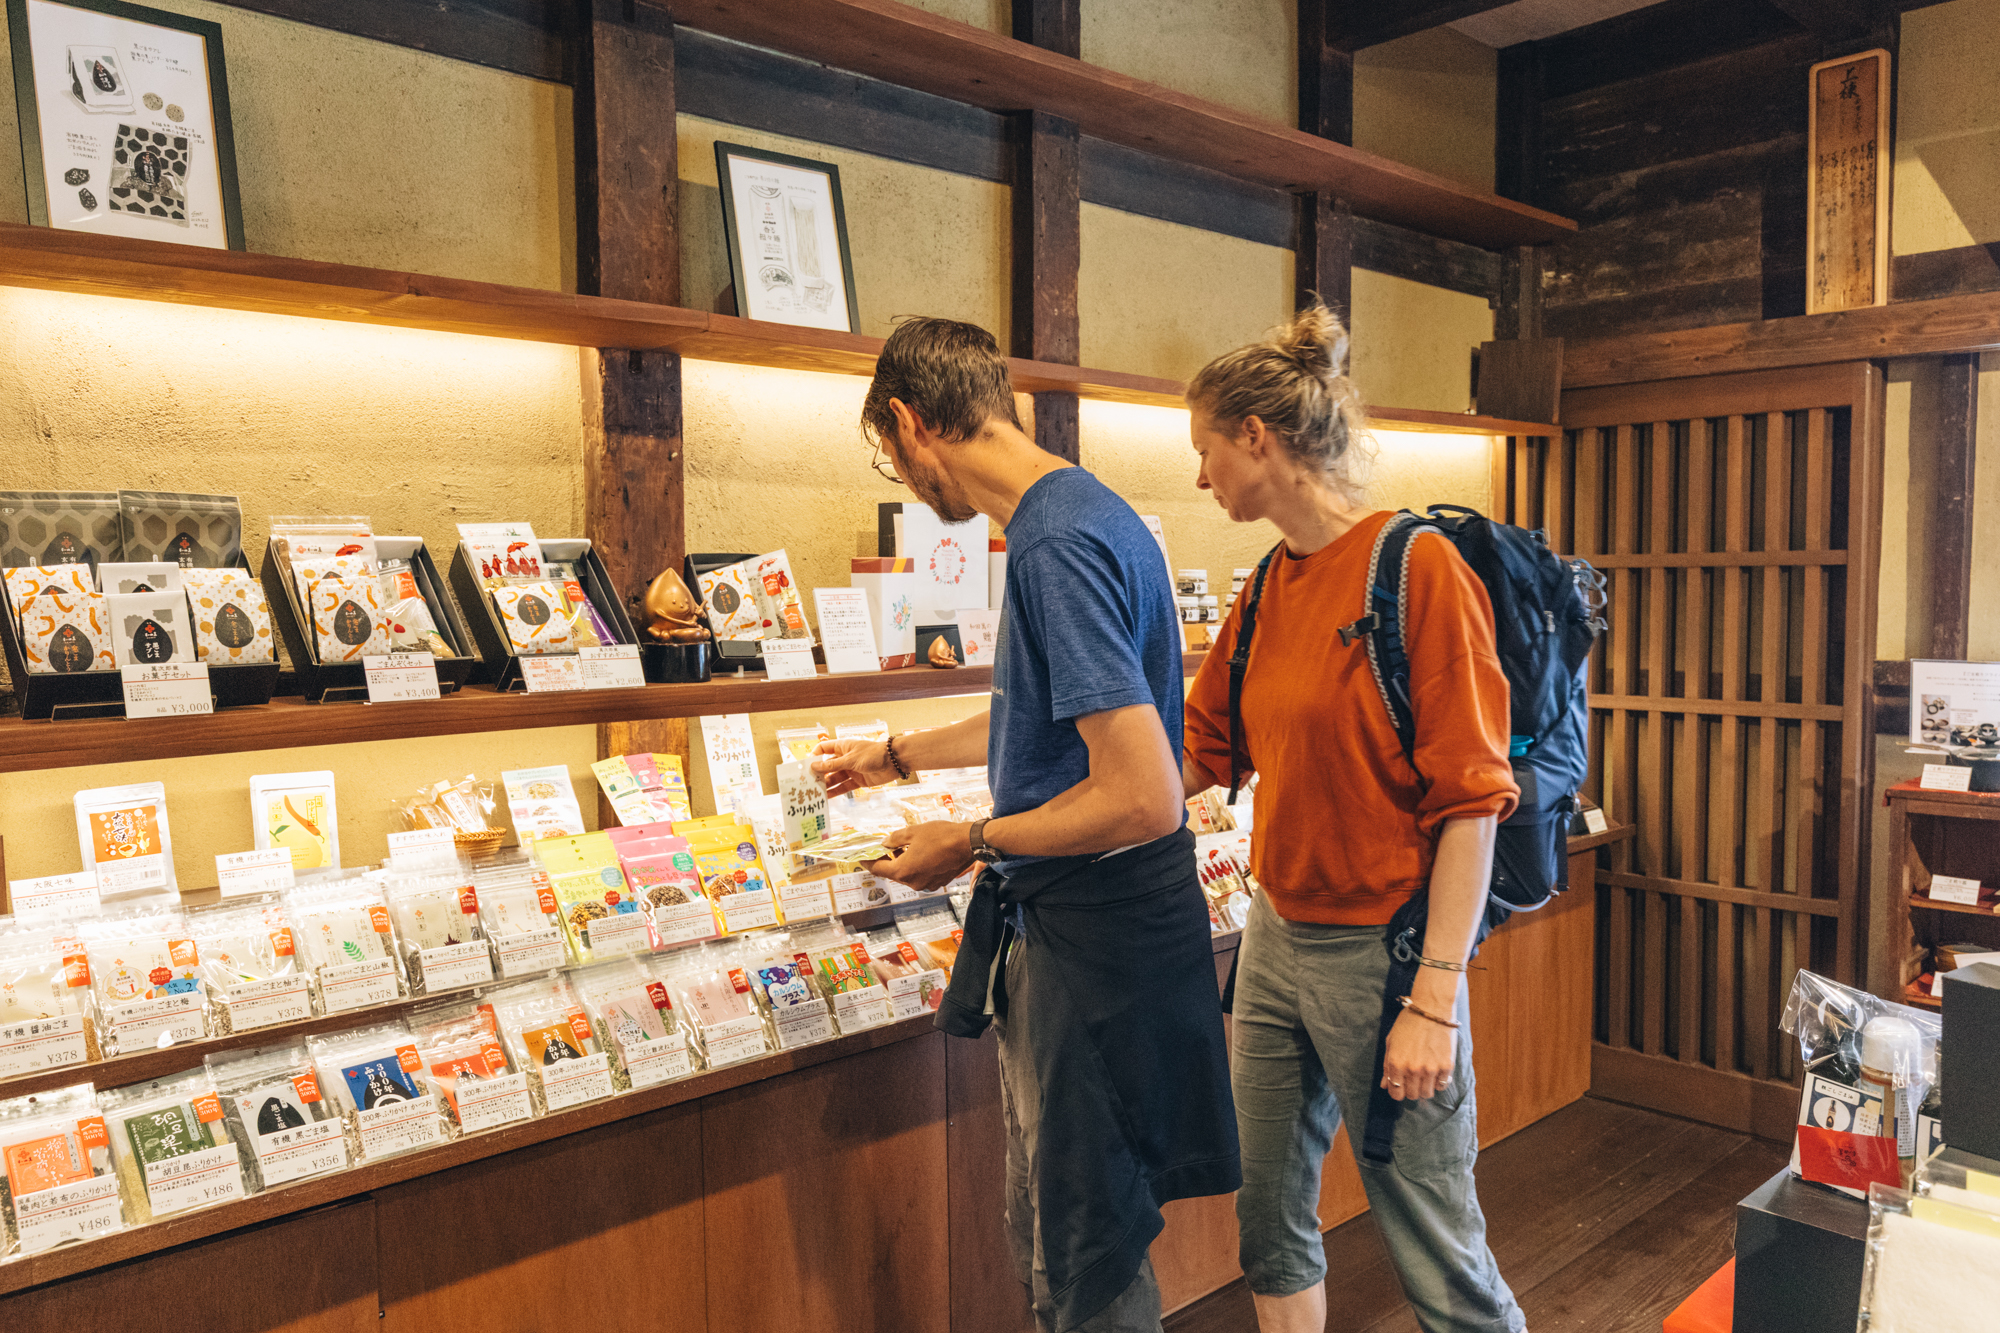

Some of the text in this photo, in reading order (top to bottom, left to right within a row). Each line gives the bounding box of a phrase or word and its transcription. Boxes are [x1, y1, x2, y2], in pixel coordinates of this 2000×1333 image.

[144, 642, 153, 659] サブレ
[377, 660, 423, 668] ごまんぞくセット
[142, 671, 192, 680] お菓子セット
[792, 669, 814, 677] ¥1,350
[615, 677, 642, 685] ¥2,600
[405, 688, 437, 697] ¥3,400
[171, 703, 210, 713] ¥3,000
[712, 750, 750, 762] ふりかけ
[788, 787, 822, 804] ごまやん
[788, 799, 825, 816] ふりかけ
[768, 846, 787, 856] ふり
[227, 851, 281, 864] 有機 ゆず七味
[34, 878, 74, 889] 大阪七味
[786, 883, 823, 896] ごまやんふりかけ
[812, 904, 828, 913] ¥378
[848, 901, 864, 910] ¥378
[756, 915, 772, 924] ¥378
[526, 931, 557, 942] ごまと味噌
[693, 927, 711, 936] ¥378
[450, 944, 486, 954] ごまと赤しそ
[626, 940, 645, 949] ¥378
[353, 961, 390, 974] ごまと山椒
[539, 957, 560, 966] ¥378
[464, 971, 486, 982] ¥378
[174, 983, 193, 994] No.2
[262, 977, 301, 990] ごまと柚子
[368, 989, 392, 1001] ¥378
[773, 983, 802, 997] カルシウム
[781, 991, 800, 1002] プラス
[847, 991, 873, 1002] 大阪セサミ
[121, 997, 189, 1016] 有機ふりかけ ごまと梅
[278, 1006, 303, 1018] ¥378
[780, 1002, 820, 1017] カルシウムプラス
[905, 1006, 922, 1015] ¥378
[868, 1012, 885, 1022] ¥378
[3, 1020, 69, 1039] 有機 醤油ごま
[721, 1024, 746, 1034] ごまとじゃこ
[809, 1027, 827, 1037] ¥378
[542, 1032, 559, 1060] ふりかけ
[552, 1029, 569, 1057] 300年
[638, 1042, 675, 1056] ごまと難波ねぎ
[742, 1044, 760, 1056] ¥378
[47, 1050, 78, 1064] ¥378
[402, 1058, 419, 1067] 300年
[665, 1064, 686, 1076] ¥378
[364, 1066, 382, 1096] ふりかけ
[376, 1063, 394, 1093] 300年
[300, 1089, 317, 1097] 300年
[585, 1086, 606, 1098] ¥378
[411, 1100, 432, 1110] かつお
[200, 1107, 219, 1116] 300年
[271, 1104, 287, 1130] 黒ごま塩
[502, 1107, 525, 1120] ¥378
[83, 1133, 104, 1141] 300年
[272, 1125, 329, 1146] 有機 黒ごま塩
[409, 1130, 433, 1144] ¥378
[148, 1160, 180, 1172] 国産ふりかけ
[163, 1157, 221, 1176] 胡豆昆ふりかけ
[312, 1154, 339, 1169] ¥356
[204, 1183, 233, 1198] ¥486
[18, 1192, 54, 1205] 国産ふりかけ
[20, 1183, 112, 1212] 梅肉と若布のふりかけ
[78, 1216, 111, 1232] ¥486
